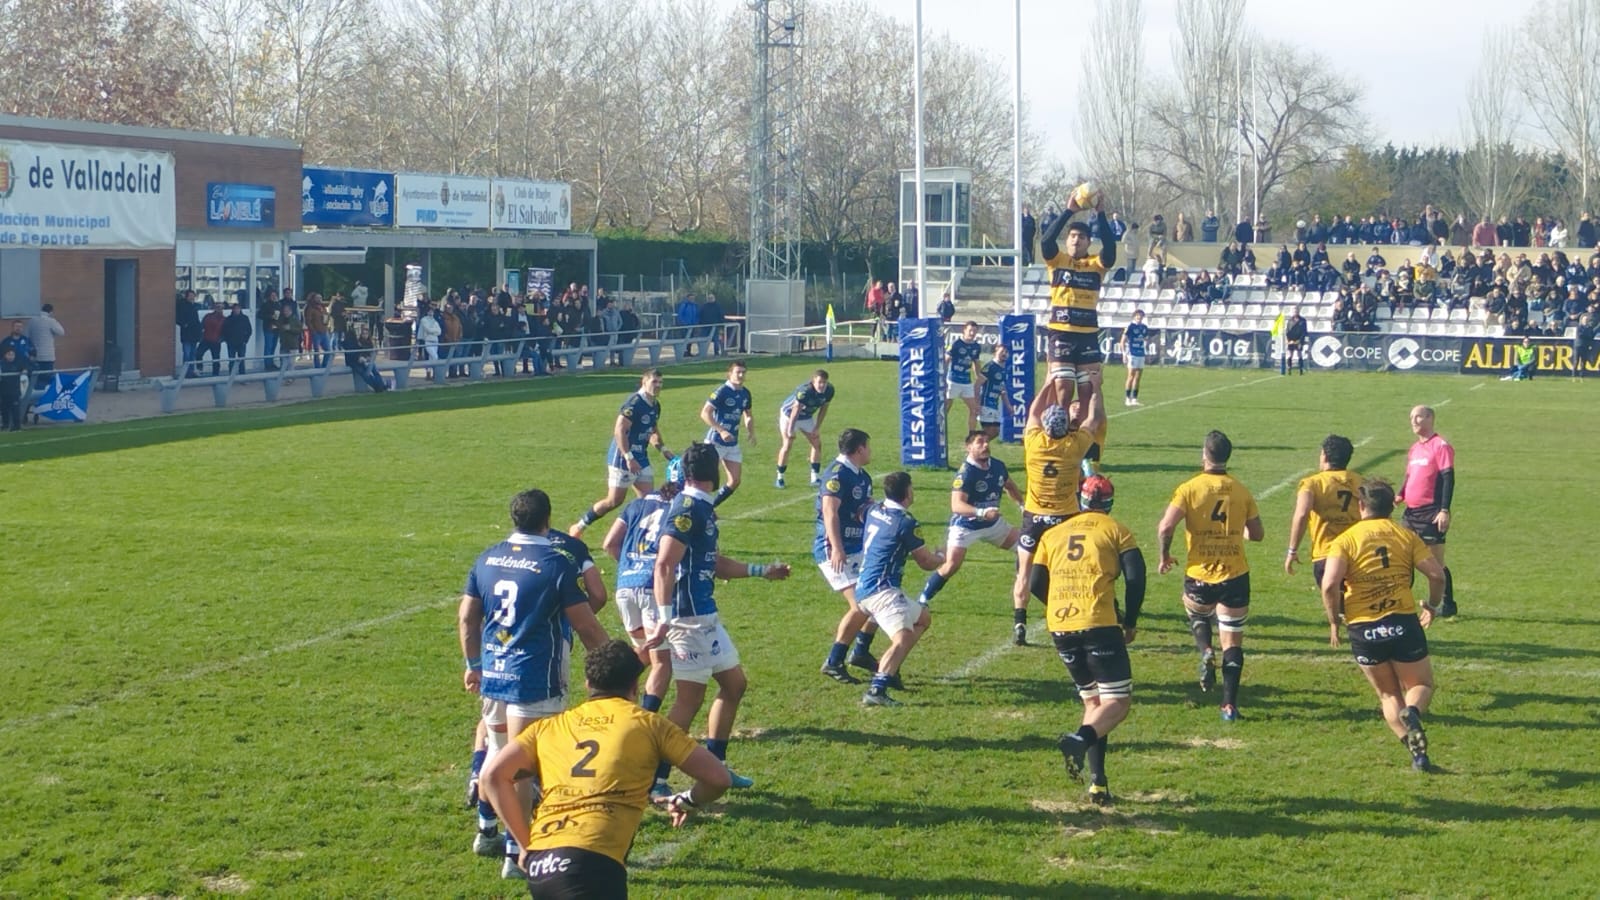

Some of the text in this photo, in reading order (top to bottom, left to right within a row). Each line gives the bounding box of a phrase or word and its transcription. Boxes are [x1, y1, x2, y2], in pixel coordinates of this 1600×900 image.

[28, 155, 161, 194] de Valladolid
[45, 215, 110, 230] Municipal
[508, 204, 558, 224] El Salvador
[0, 231, 89, 246] de Deportes
[1209, 338, 1250, 356] 016
[1343, 346, 1382, 359] COPE
[1421, 348, 1461, 362] COPE
[1011, 338, 1026, 440] LESAFFRE
[1043, 461, 1058, 478] 6
[1211, 499, 1228, 524] 4
[1337, 490, 1353, 512] 7
[639, 508, 664, 542] 4
[864, 524, 880, 555] 7
[1067, 534, 1086, 561] 5
[485, 556, 537, 572] meléndez
[1375, 546, 1390, 568] 1
[494, 579, 518, 627] 3
[570, 739, 600, 778] 2
